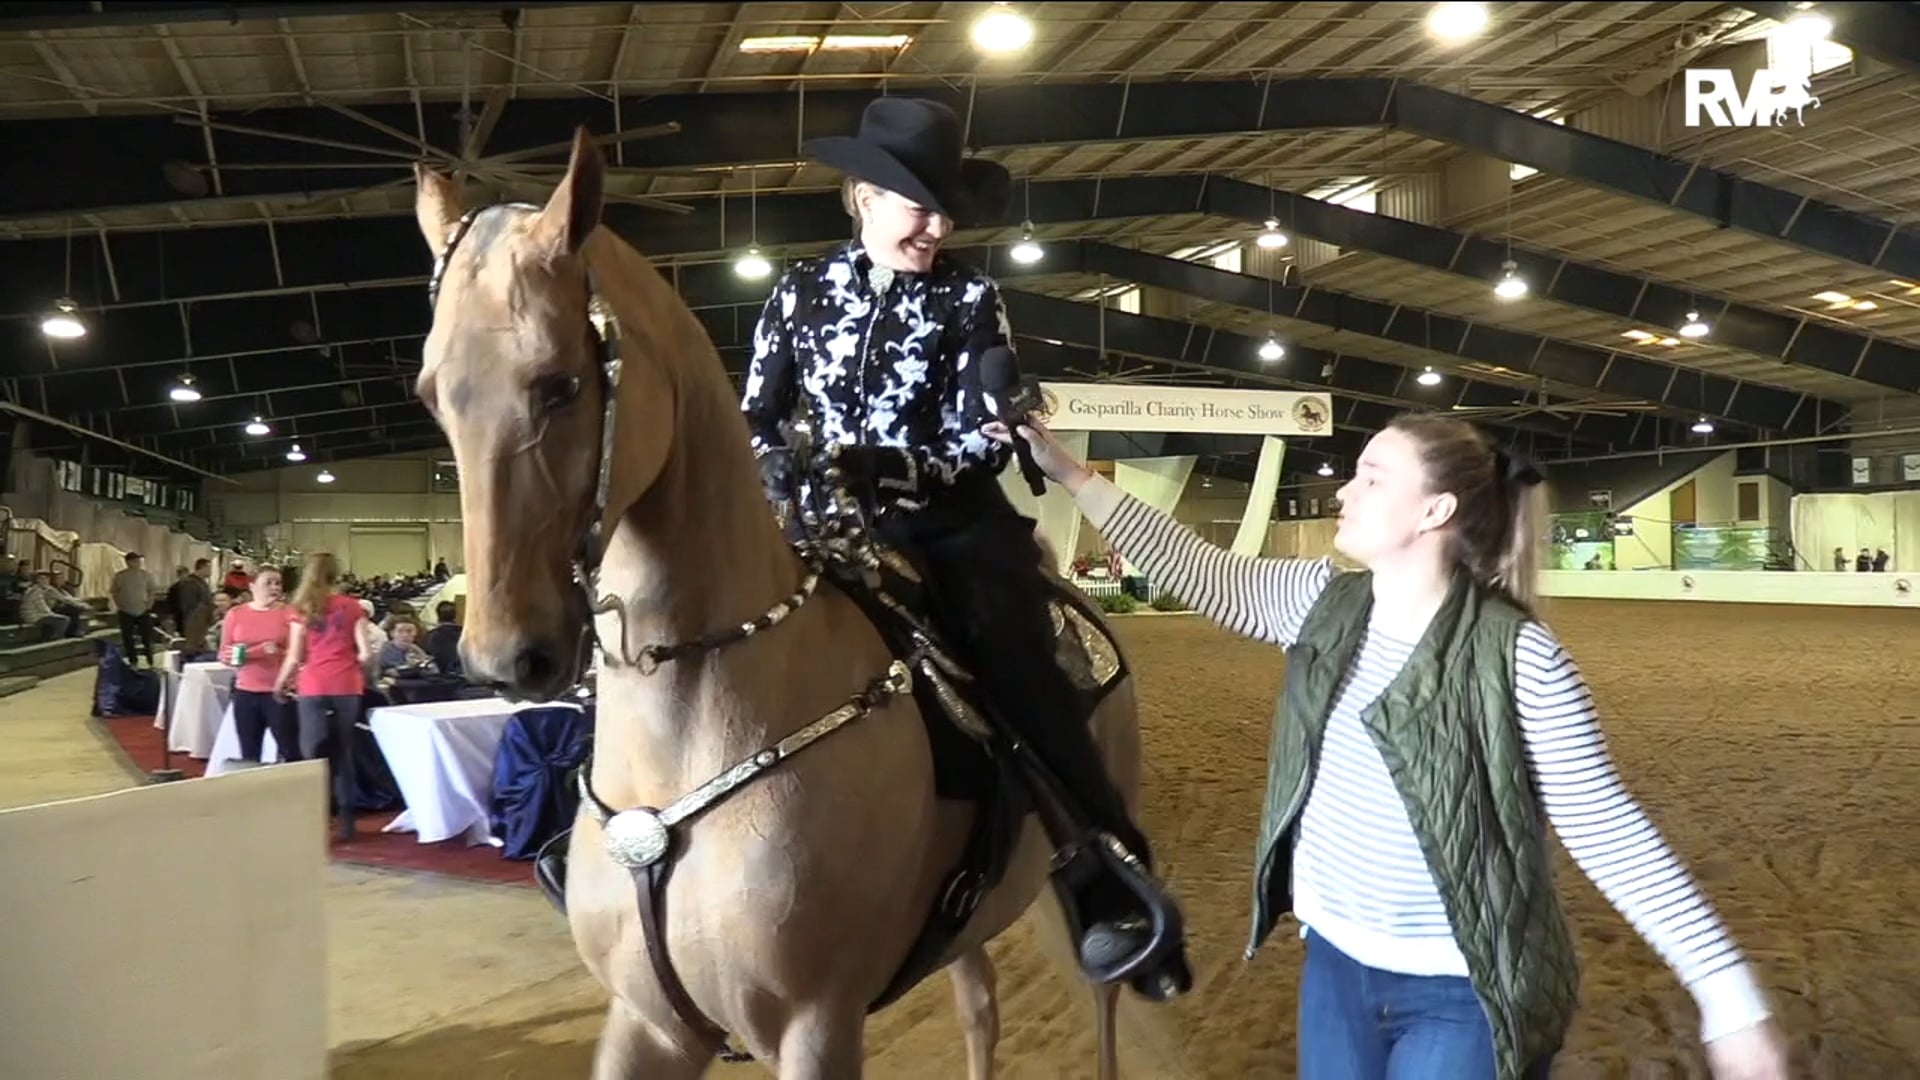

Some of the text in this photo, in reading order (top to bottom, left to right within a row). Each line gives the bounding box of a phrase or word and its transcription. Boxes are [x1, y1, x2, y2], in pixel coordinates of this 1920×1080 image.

[1068, 398, 1142, 418] Gasparilla
[1146, 401, 1198, 421] Charity
[1201, 403, 1244, 419] Horse
[1247, 404, 1285, 419] Show
